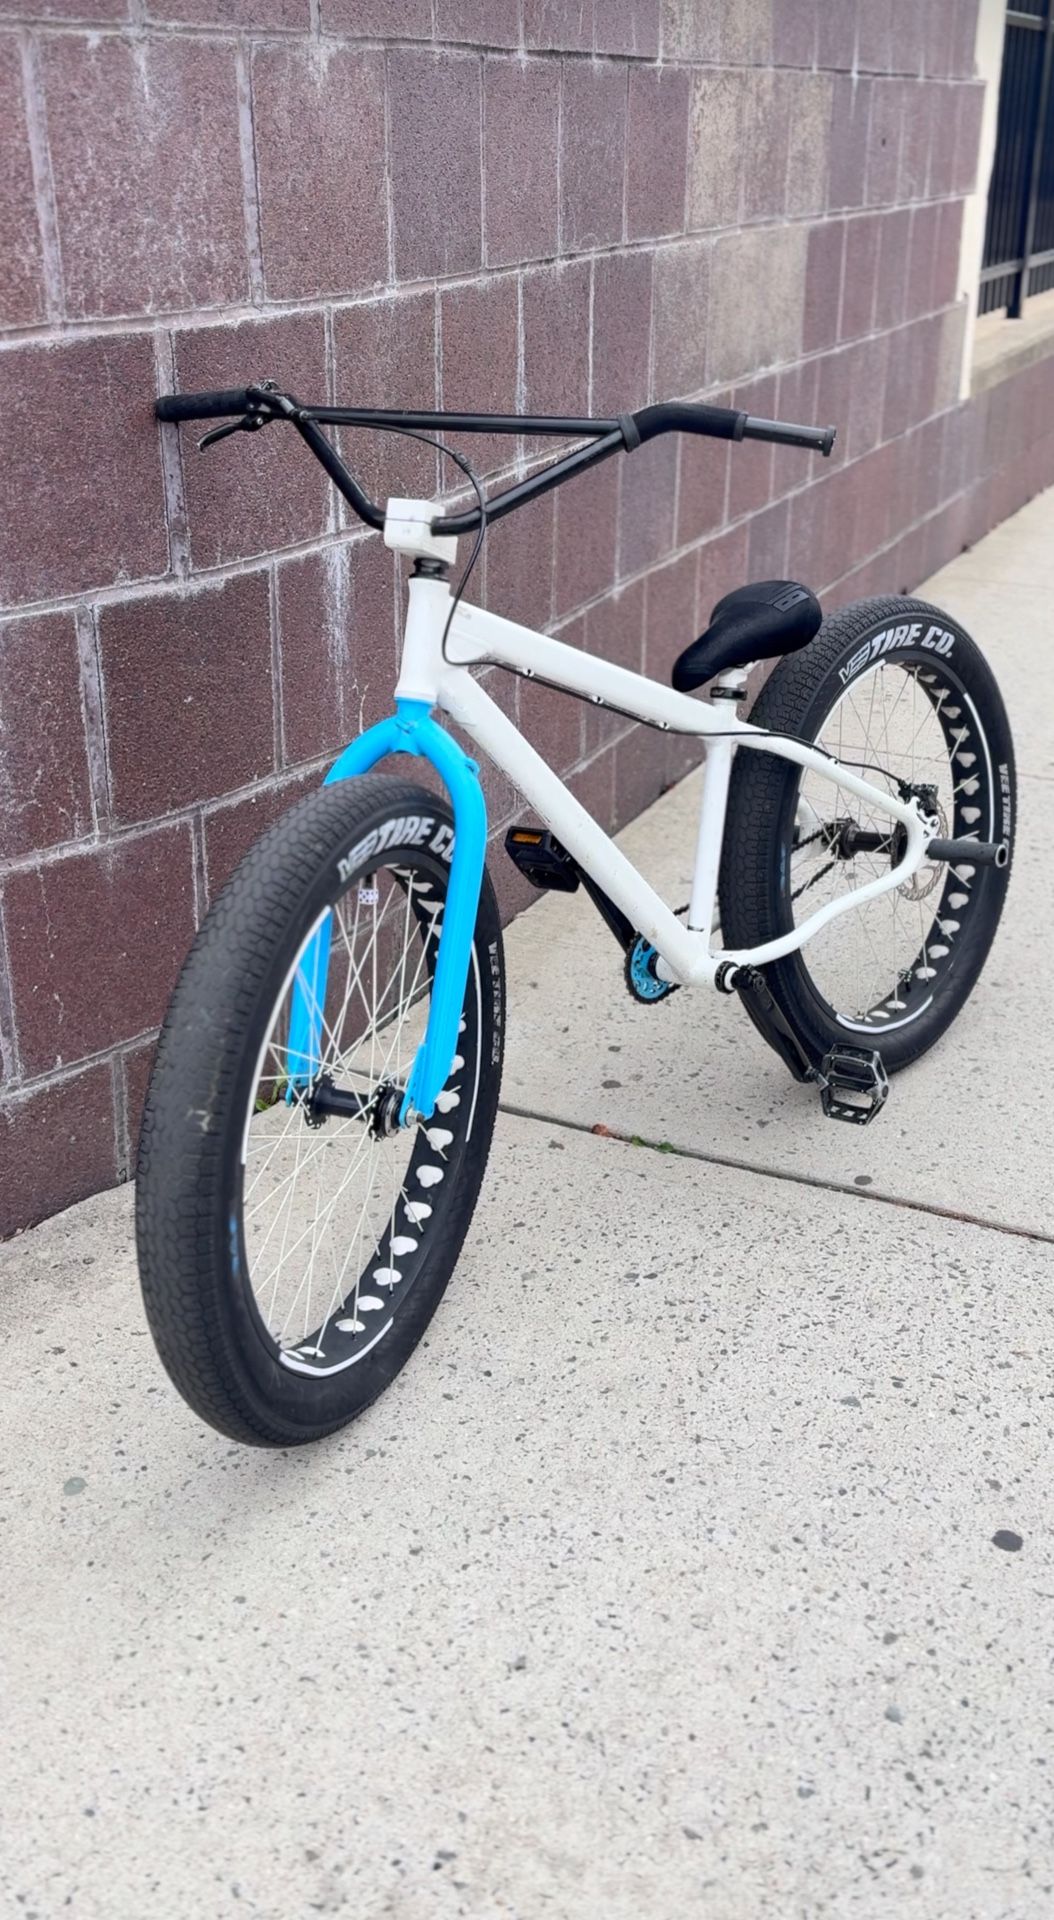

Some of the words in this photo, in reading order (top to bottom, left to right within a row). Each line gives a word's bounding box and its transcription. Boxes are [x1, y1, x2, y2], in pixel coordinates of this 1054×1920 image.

[869, 623, 924, 662] TIRE
[920, 625, 956, 659] CO.
[372, 815, 436, 856] TIRE
